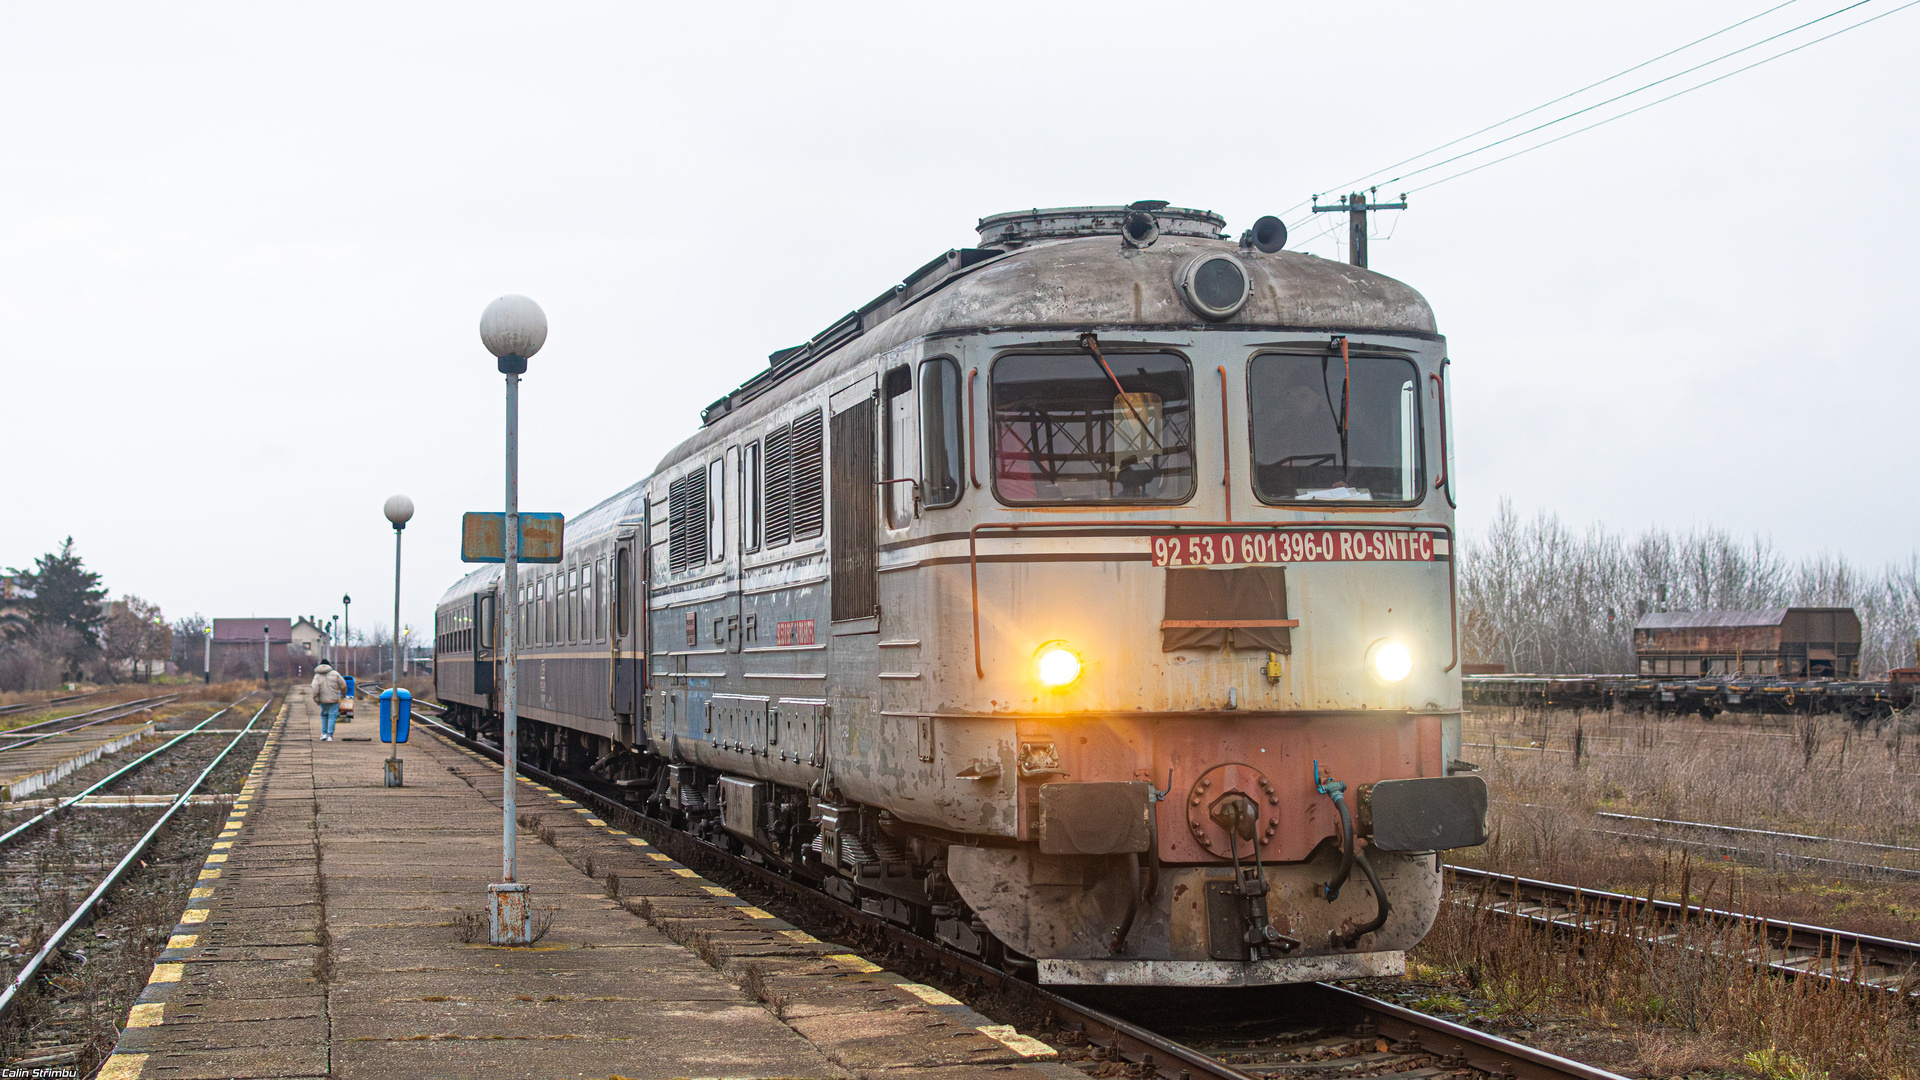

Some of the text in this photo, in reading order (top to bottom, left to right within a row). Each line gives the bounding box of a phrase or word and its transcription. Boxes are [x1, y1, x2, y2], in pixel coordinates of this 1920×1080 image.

[1155, 531, 1431, 566] 92 53 0 601396-0 RO-SNTFC
[713, 612, 757, 644] CFR
